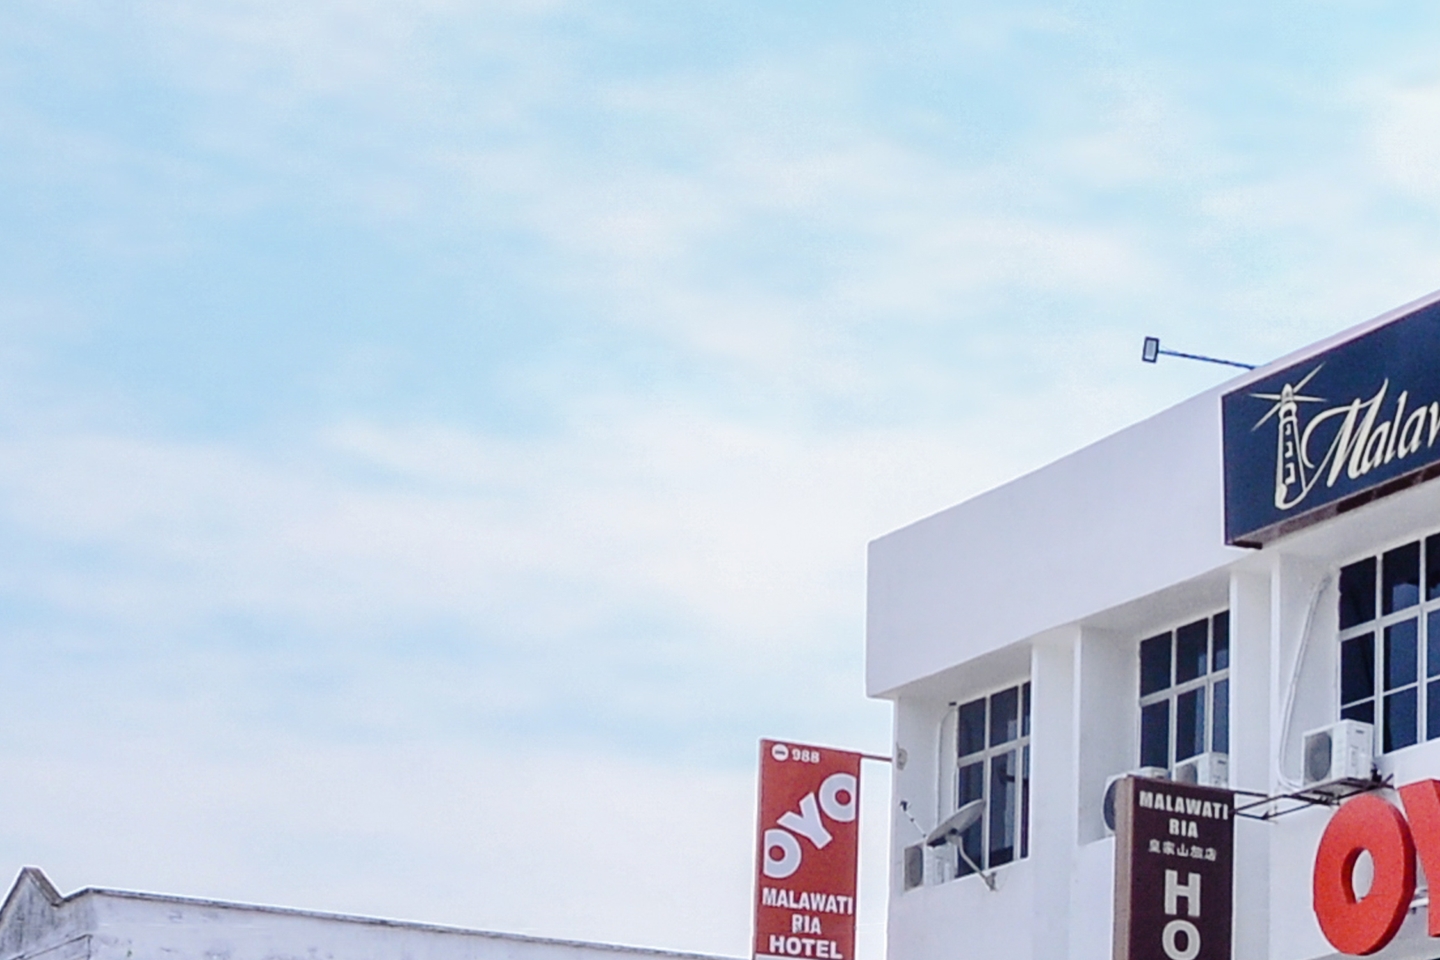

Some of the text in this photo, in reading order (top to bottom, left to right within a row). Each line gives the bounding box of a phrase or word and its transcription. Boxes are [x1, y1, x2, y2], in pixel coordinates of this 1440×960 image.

[1138, 790, 1229, 820] MALAWATI
[763, 772, 857, 879] OYO
[1168, 817, 1198, 838] RIA
[762, 886, 853, 915] MALAWATI
[792, 913, 822, 935] RIA
[768, 934, 843, 960] HOTEL
